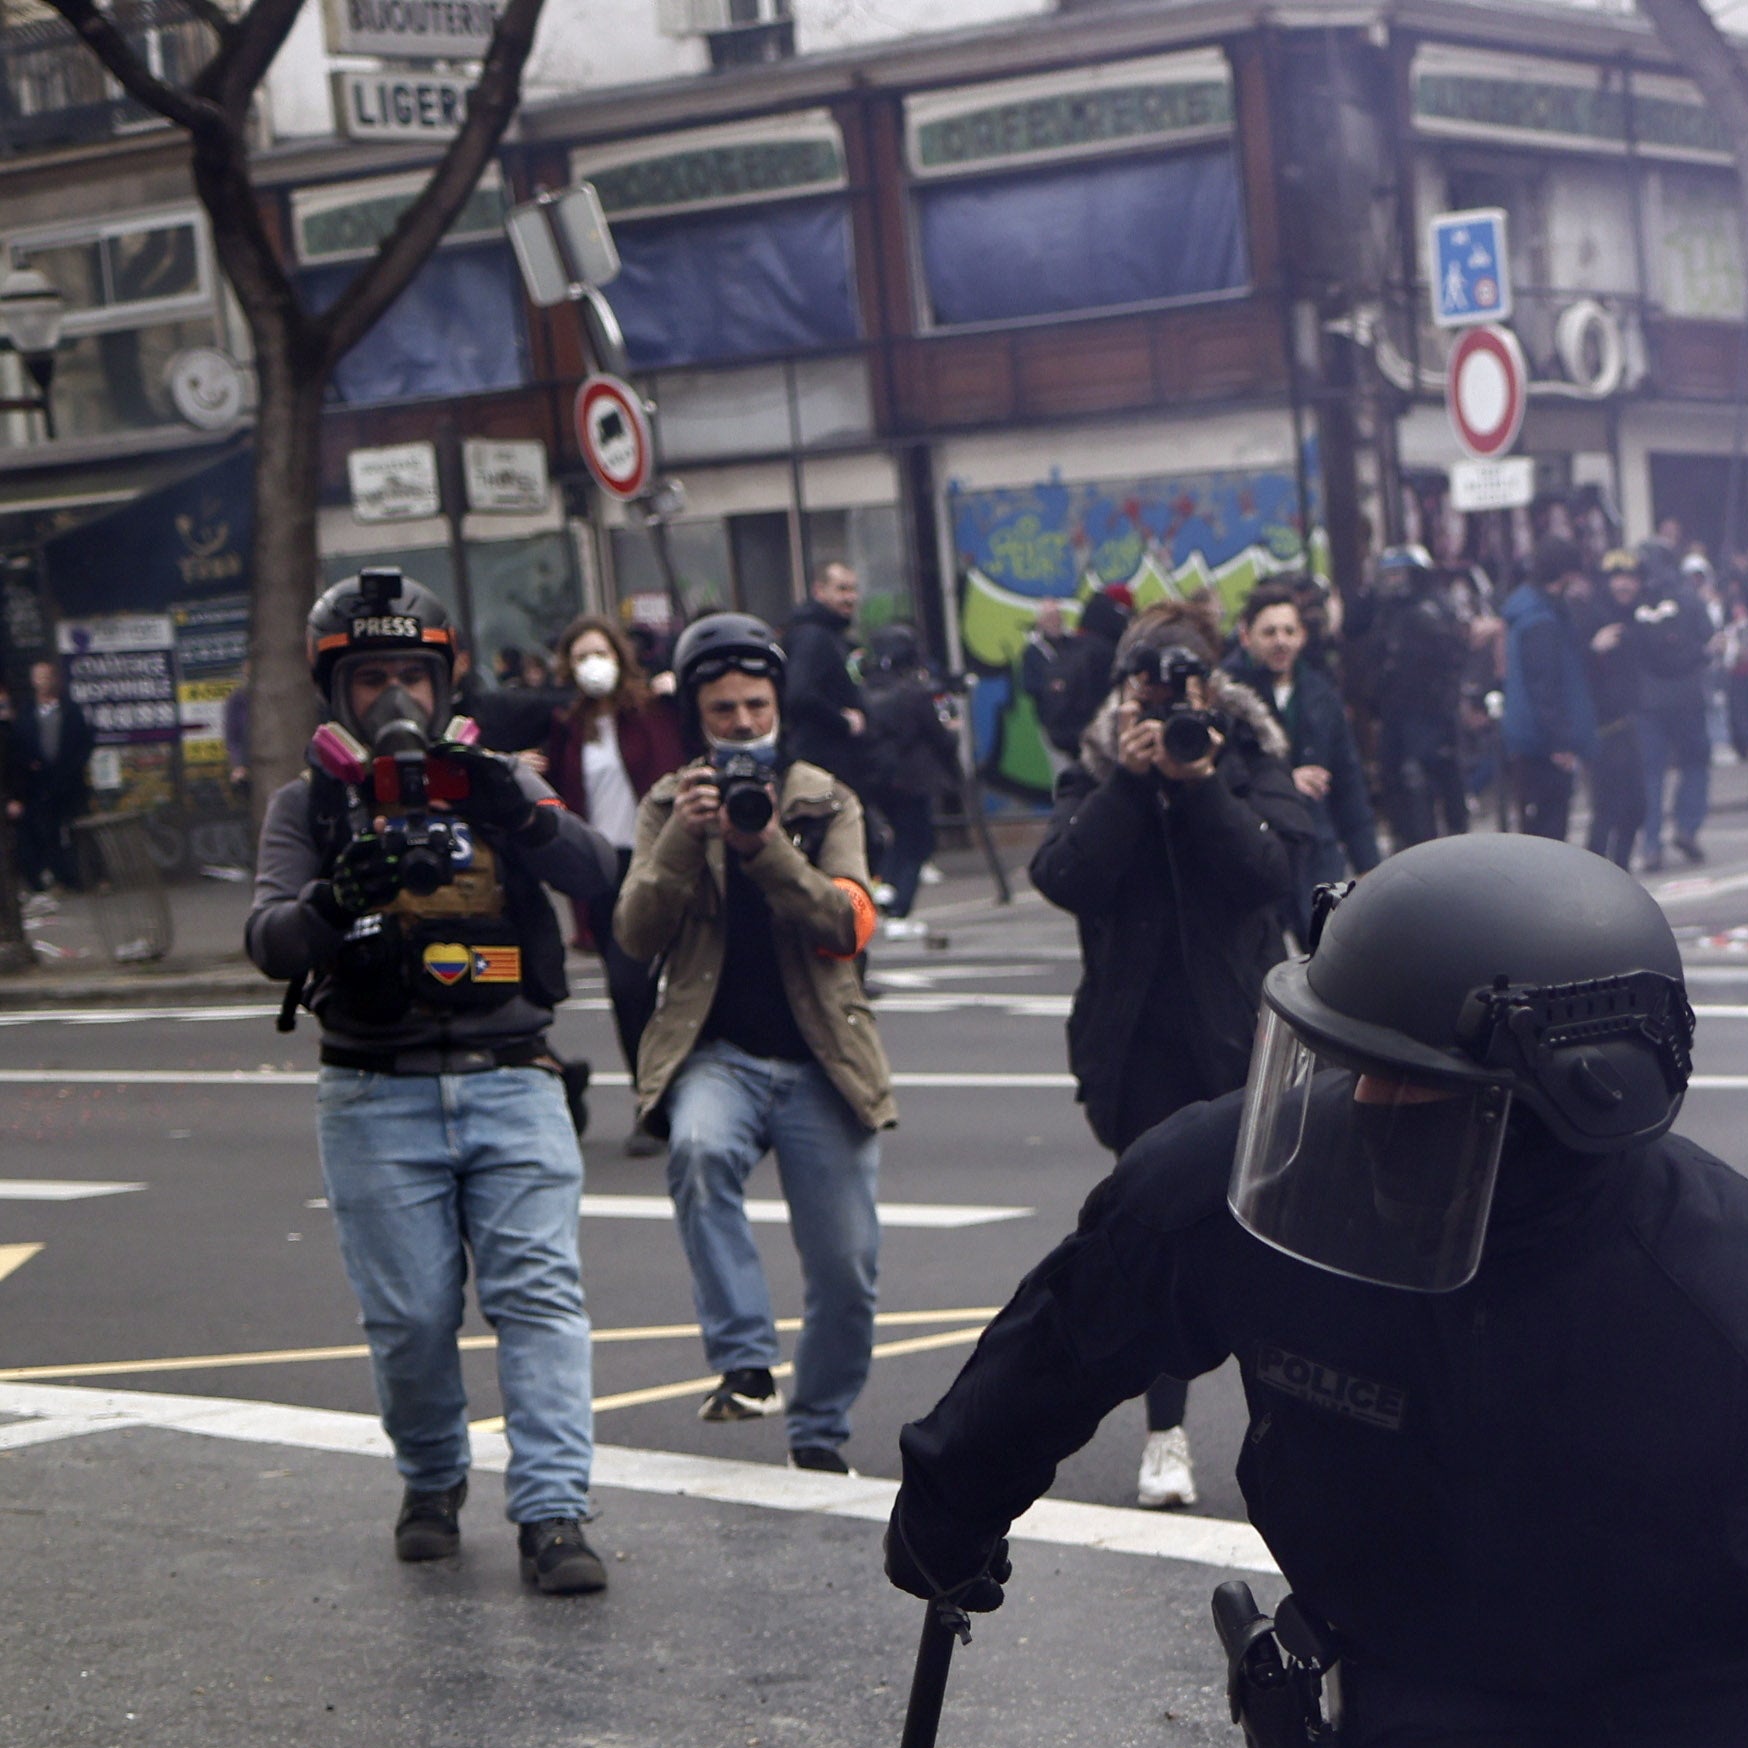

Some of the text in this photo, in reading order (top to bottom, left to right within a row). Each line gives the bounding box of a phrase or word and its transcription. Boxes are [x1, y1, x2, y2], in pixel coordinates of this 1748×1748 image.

[353, 81, 478, 126] LIGER
[353, 616, 418, 638] PRESS
[1258, 1348, 1403, 1417] POLICE
